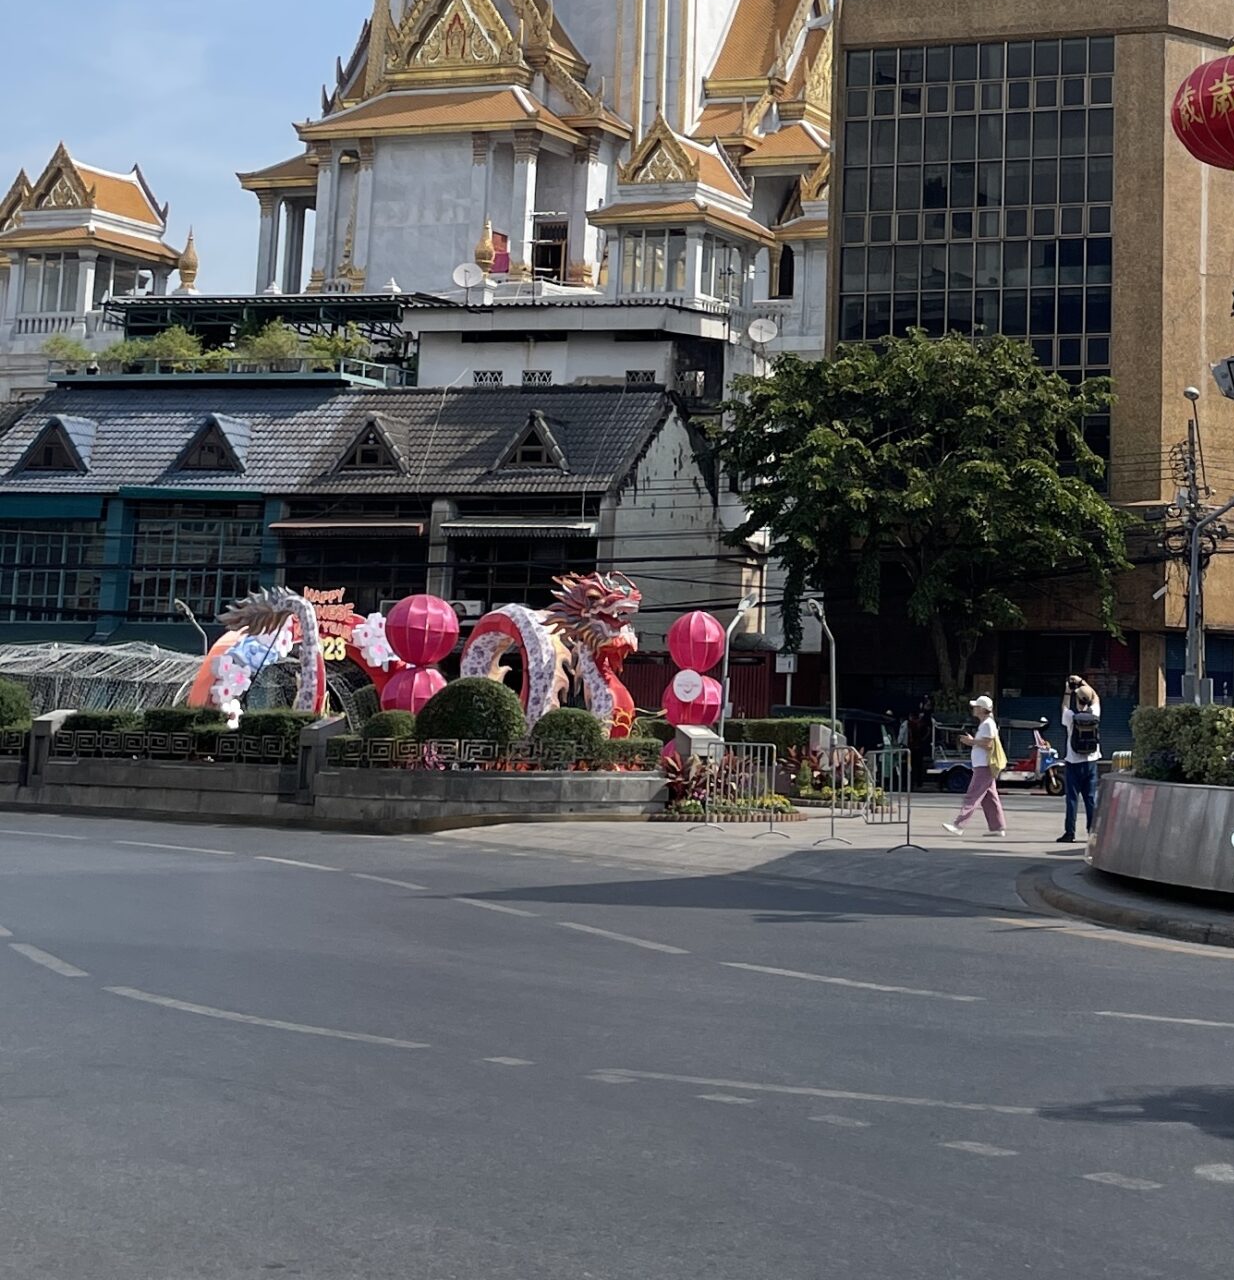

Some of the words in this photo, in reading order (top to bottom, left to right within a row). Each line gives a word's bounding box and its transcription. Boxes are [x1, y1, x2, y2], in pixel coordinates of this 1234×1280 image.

[303, 585, 346, 604] HAPPY
[314, 602, 355, 623] NESE
[319, 636, 347, 661] 23
